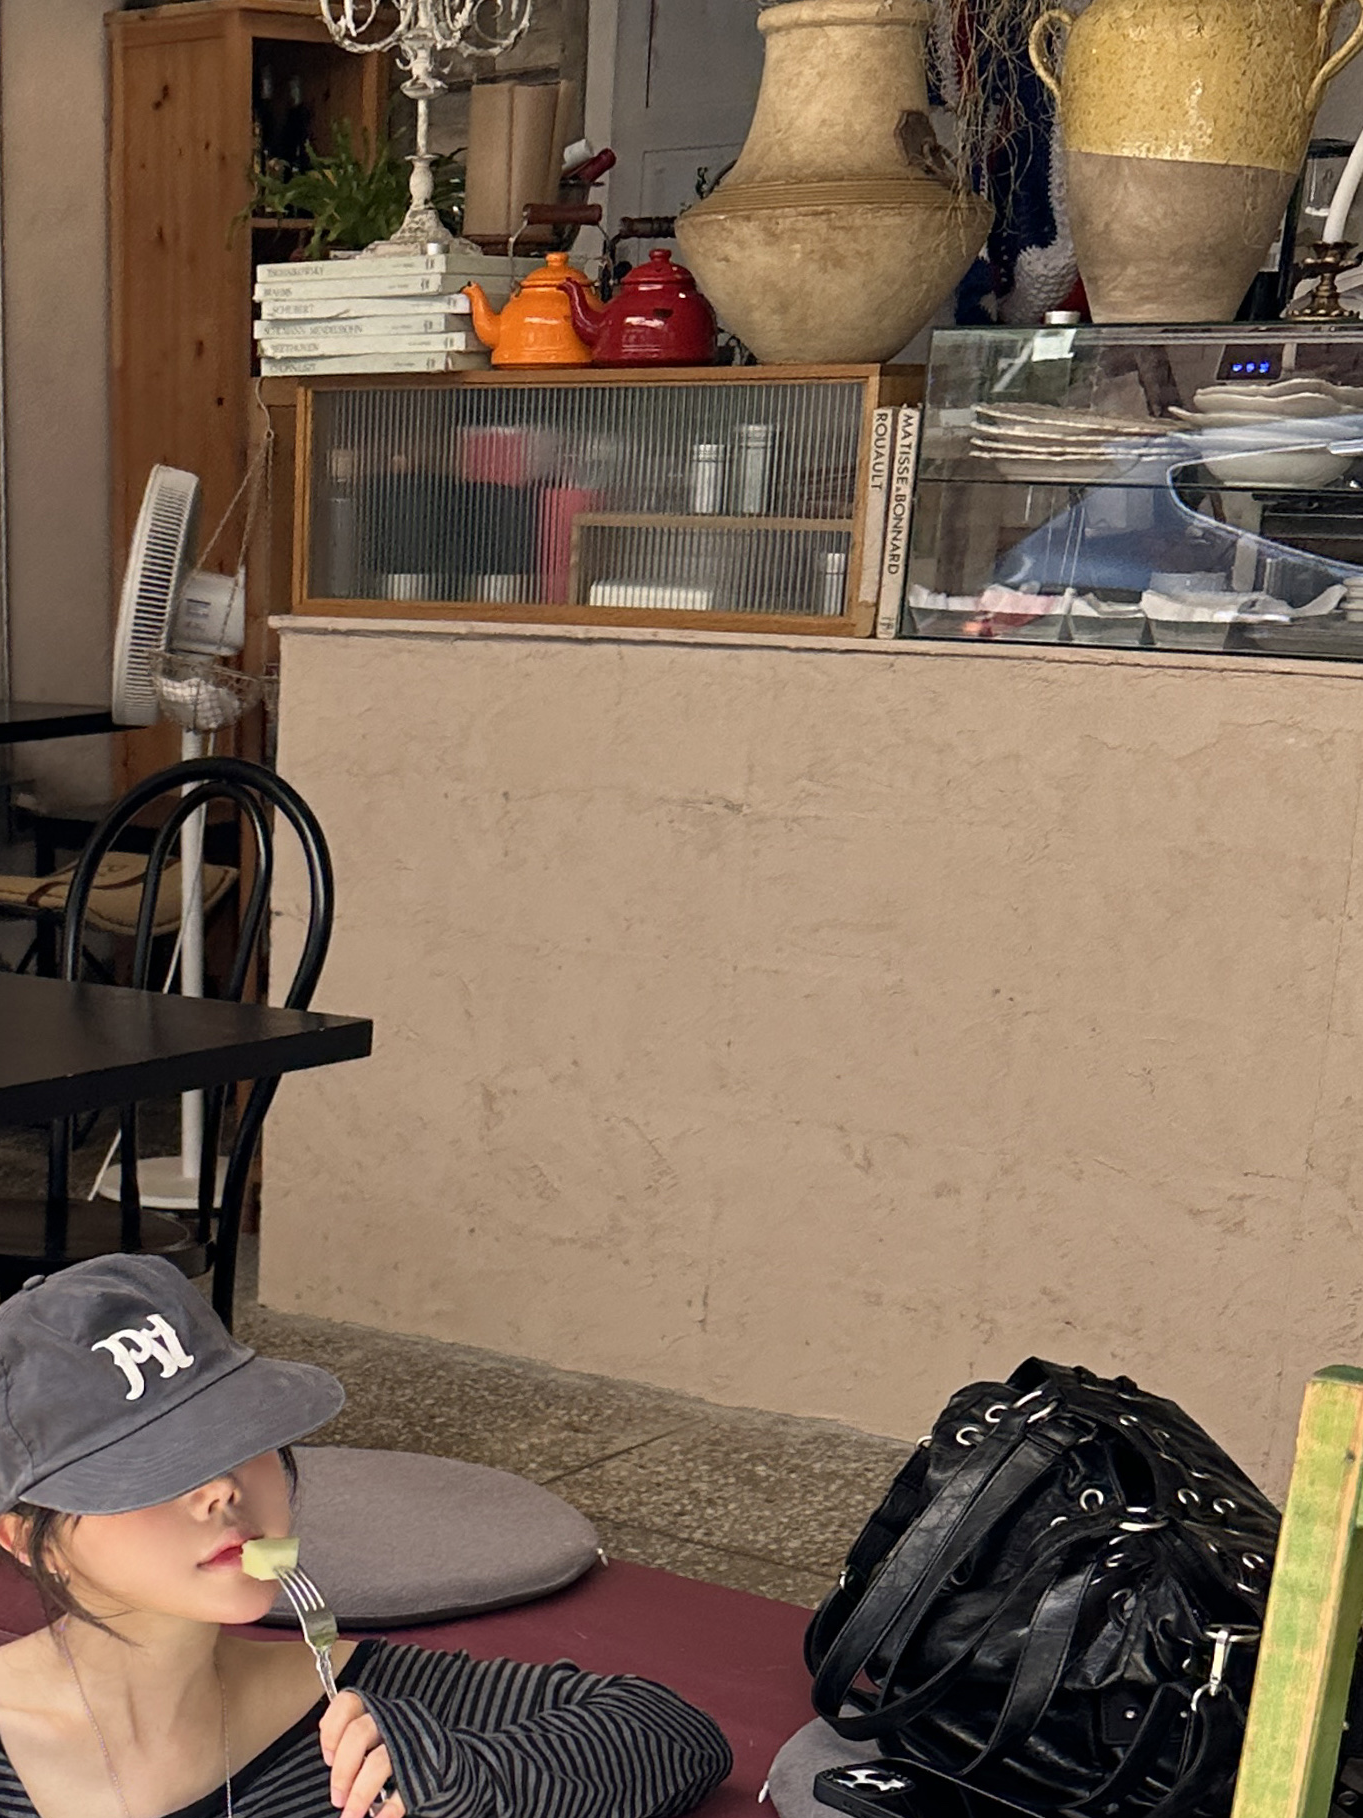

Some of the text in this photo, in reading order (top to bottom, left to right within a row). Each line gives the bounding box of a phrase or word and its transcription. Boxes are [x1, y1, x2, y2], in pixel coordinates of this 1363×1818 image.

[871, 411, 888, 491] ROUAULT
[895, 412, 914, 487] MATISSE
[888, 493, 908, 576] BONNARD
